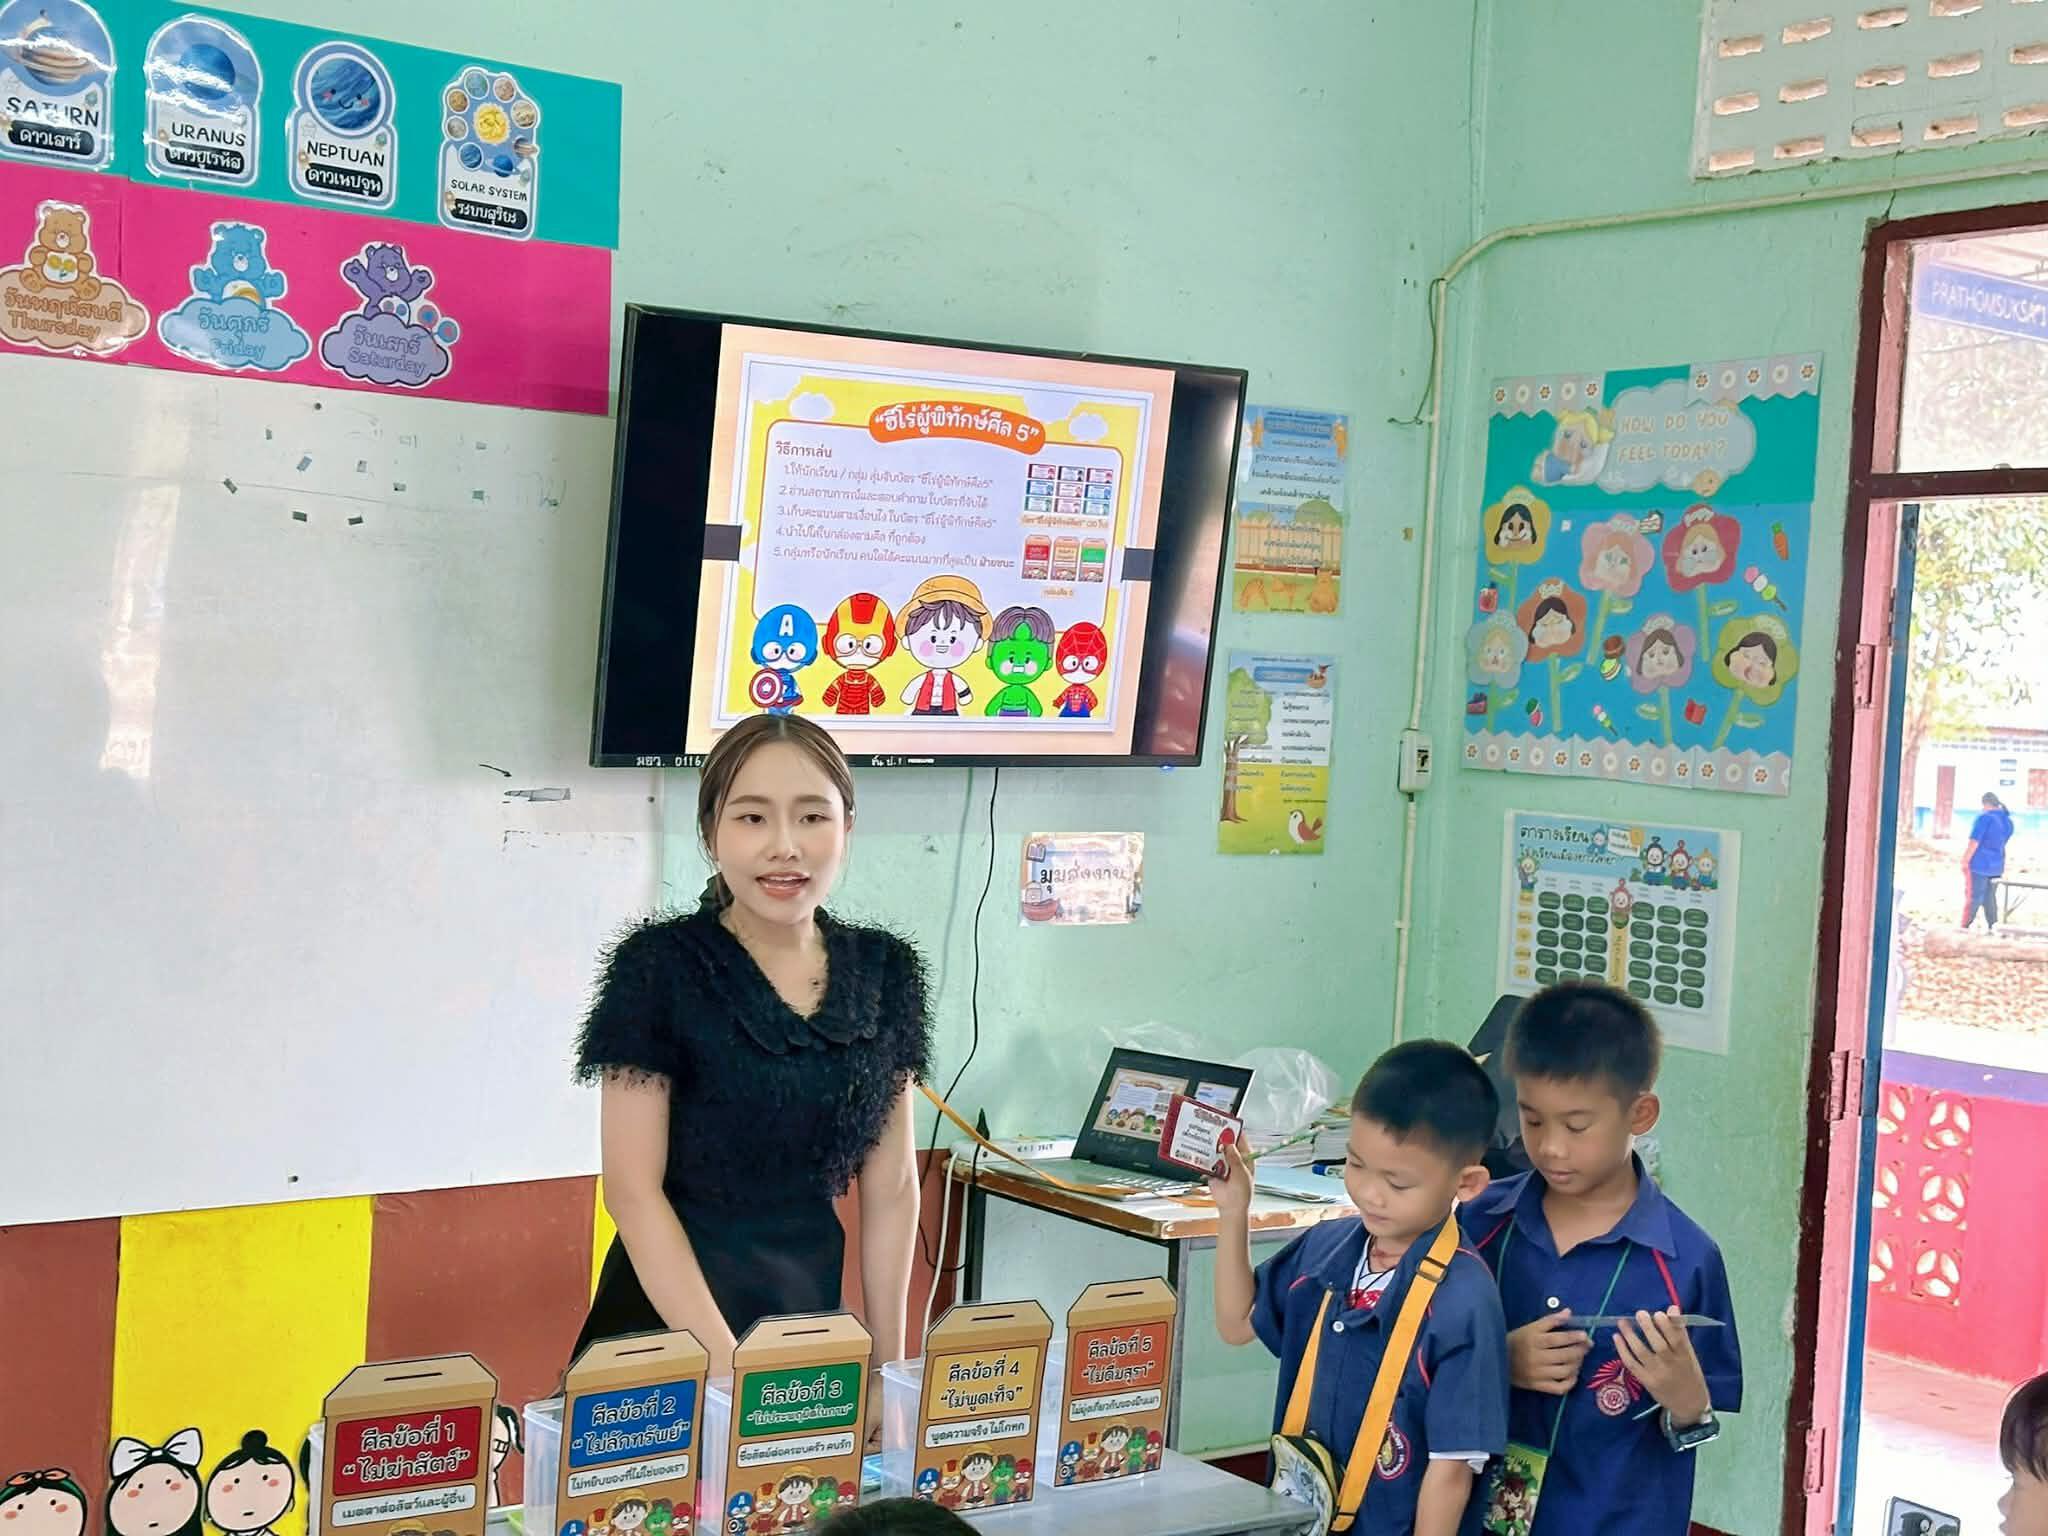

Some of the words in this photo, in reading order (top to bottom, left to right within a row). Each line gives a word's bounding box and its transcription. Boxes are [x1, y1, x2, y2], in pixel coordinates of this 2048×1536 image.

[20, 128, 81, 150] ดาวเสาร์
[172, 122, 247, 147] URANUS
[306, 140, 385, 167] NEPTUAN
[450, 179, 486, 194] SOLAR
[488, 185, 527, 201] SYSTEM
[456, 202, 518, 225] ระบบสุริยะ
[8, 310, 101, 343] Thursday
[199, 306, 270, 340] วันศุกร์
[353, 325, 421, 354] วันเสาร์
[348, 347, 427, 377] Saturday
[1664, 415, 1687, 430] DO
[1696, 411, 1728, 430] YOU
[775, 440, 833, 459] วิธีการเล่น
[1618, 446, 1656, 463] FEEL
[1088, 1329, 1142, 1360] ศีลข้อที่
[1143, 1336, 1153, 1352] 5
[948, 1353, 1007, 1383] ศีลข้อที่
[1008, 1361, 1020, 1376] 4
[761, 1373, 827, 1405] ศีลข้อที่
[828, 1380, 842, 1399] 3
[940, 1384, 1024, 1412] “ไม่พูดเท็จ”
[592, 1389, 661, 1426] ศีลข้อที่
[661, 1395, 677, 1416] 2
[361, 1414, 441, 1452] ศีลข้อที่
[444, 1421, 456, 1442] 1
